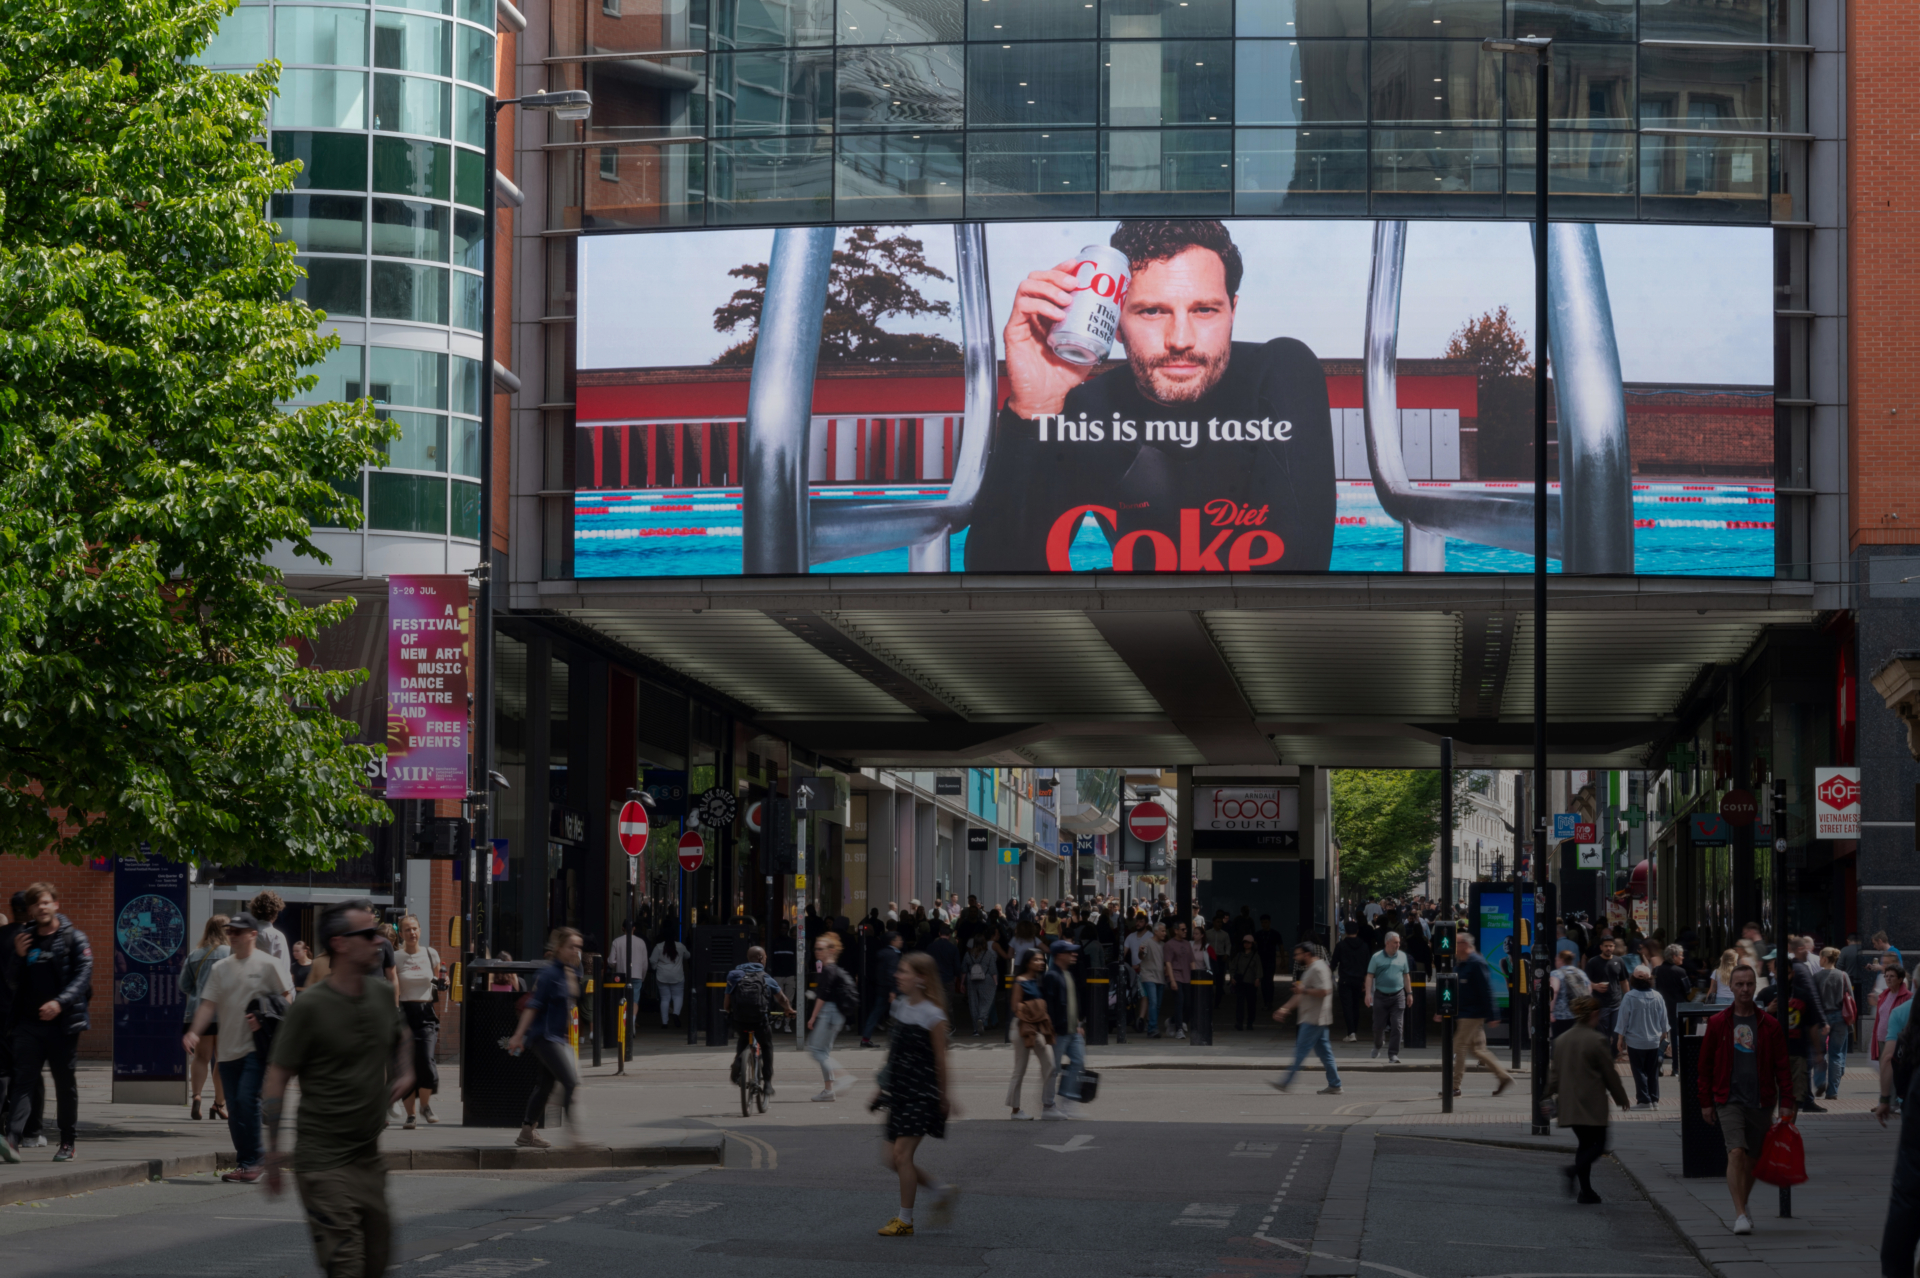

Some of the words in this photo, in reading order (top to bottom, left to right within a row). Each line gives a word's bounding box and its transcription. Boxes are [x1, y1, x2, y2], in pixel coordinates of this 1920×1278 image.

[1096, 303, 1116, 323] This
[1088, 312, 1098, 324] is
[1100, 320, 1115, 336] my
[1086, 324, 1112, 344] taste
[1032, 413, 1105, 442] This
[1112, 412, 1137, 442] is
[1145, 418, 1198, 448] my
[1208, 417, 1292, 442] taste
[1204, 499, 1270, 527] Diet
[1046, 504, 1285, 572] Coke
[444, 604, 453, 616] A
[393, 619, 461, 630] FESTIVAL
[401, 633, 418, 645] OF
[401, 648, 427, 660] NEW
[436, 648, 461, 660] ART
[418, 663, 461, 674] MUSIC
[401, 678, 444, 689] DANCE
[392, 692, 452, 703] THEATRE
[401, 707, 426, 718] AND
[426, 722, 461, 733] FREE
[409, 736, 461, 747] EVENTS
[391, 767, 434, 781] MIF
[651, 788, 680, 797] TSB
[700, 790, 715, 812] BLACK
[716, 788, 736, 807] SHEEP
[1213, 790, 1280, 819] food
[708, 812, 734, 827] COFFEE
[1211, 821, 1281, 829] COURT
[1820, 824, 1842, 833] STREET
[1257, 836, 1282, 844] LIFTS
